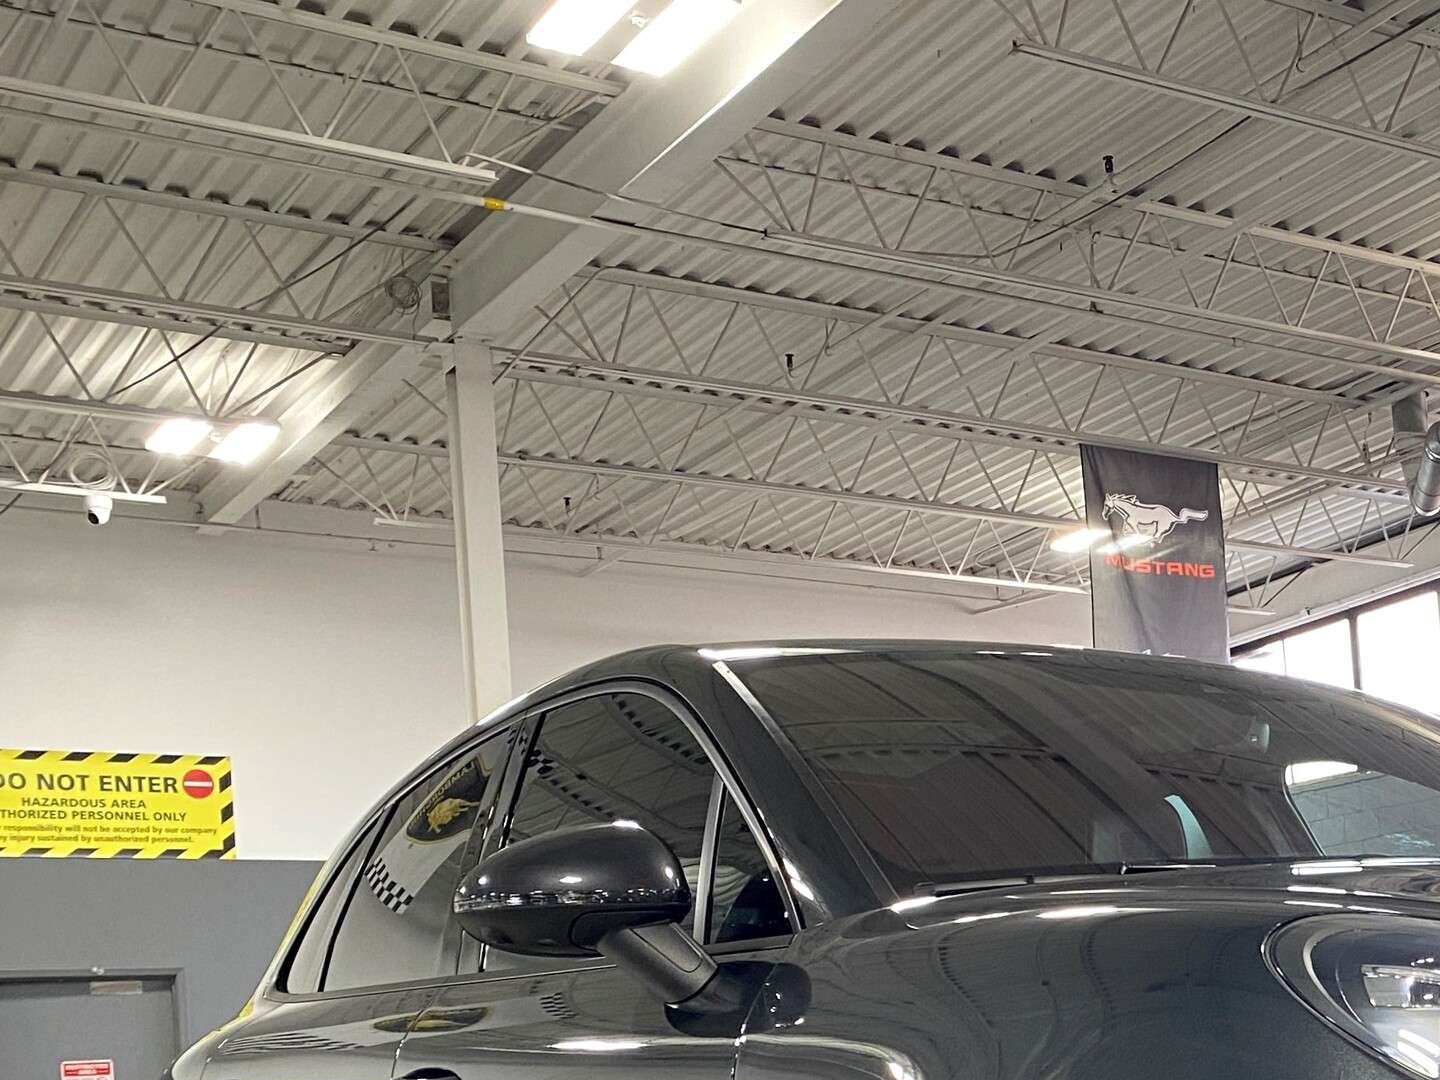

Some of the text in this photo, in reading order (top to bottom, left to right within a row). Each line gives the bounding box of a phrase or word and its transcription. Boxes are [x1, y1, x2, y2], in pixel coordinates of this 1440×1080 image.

[1104, 554, 1216, 579] MUSTANG
[36, 773, 90, 791] NOT
[99, 775, 179, 793] ENTER
[22, 797, 147, 809] HAZARDOUS AREA
[72, 810, 149, 821] PERSONNEL
[153, 811, 187, 822] ONLY
